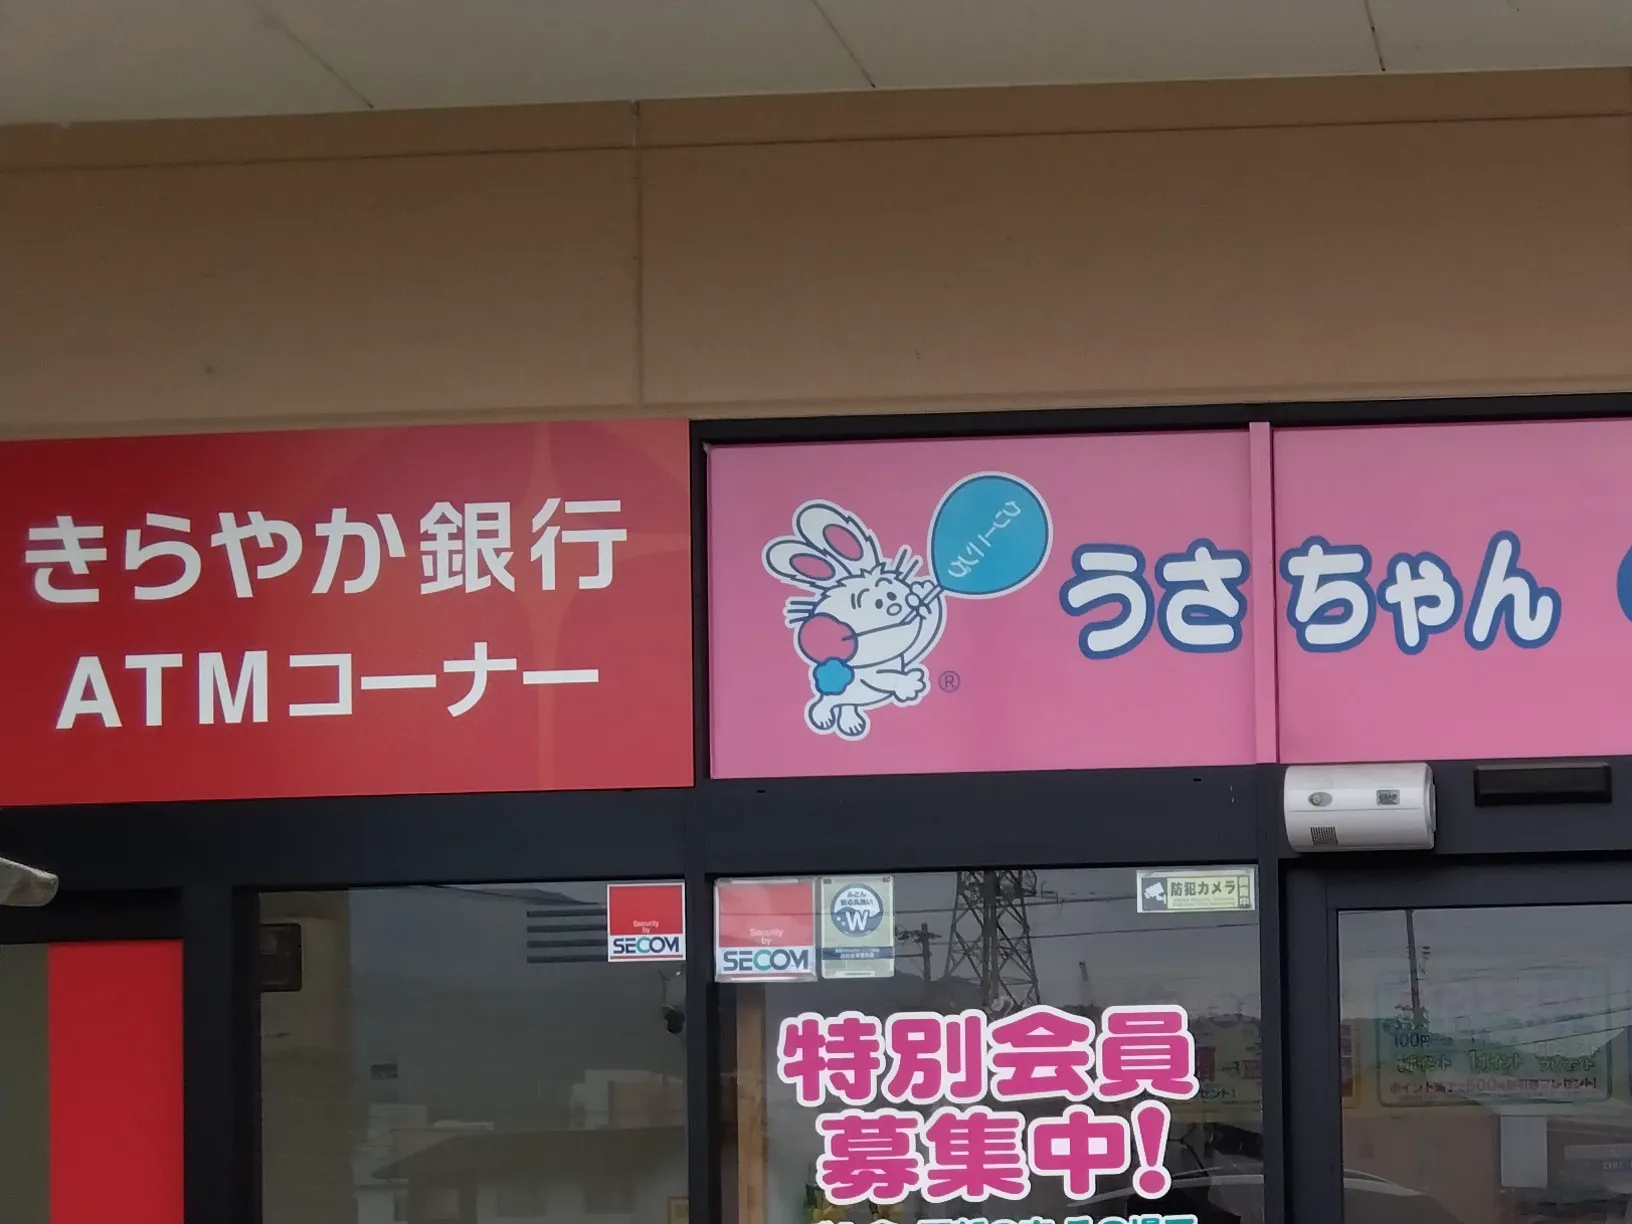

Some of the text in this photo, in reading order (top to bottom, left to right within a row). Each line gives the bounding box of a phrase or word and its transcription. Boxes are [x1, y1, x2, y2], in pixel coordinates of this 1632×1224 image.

[25, 497, 627, 603] きらやか銀行
[1060, 529, 1561, 660] うさちゃん
[55, 642, 599, 729] ATMコーナー
[1171, 881, 1236, 896] 防犯カメラ
[633, 920, 659, 929] Security
[750, 928, 784, 938] Security
[613, 936, 679, 954] SECOM
[761, 937, 771, 945] by
[723, 949, 808, 972] SECOM
[778, 1005, 1200, 1106] 特別会員
[817, 1100, 1172, 1204] 募集中!
